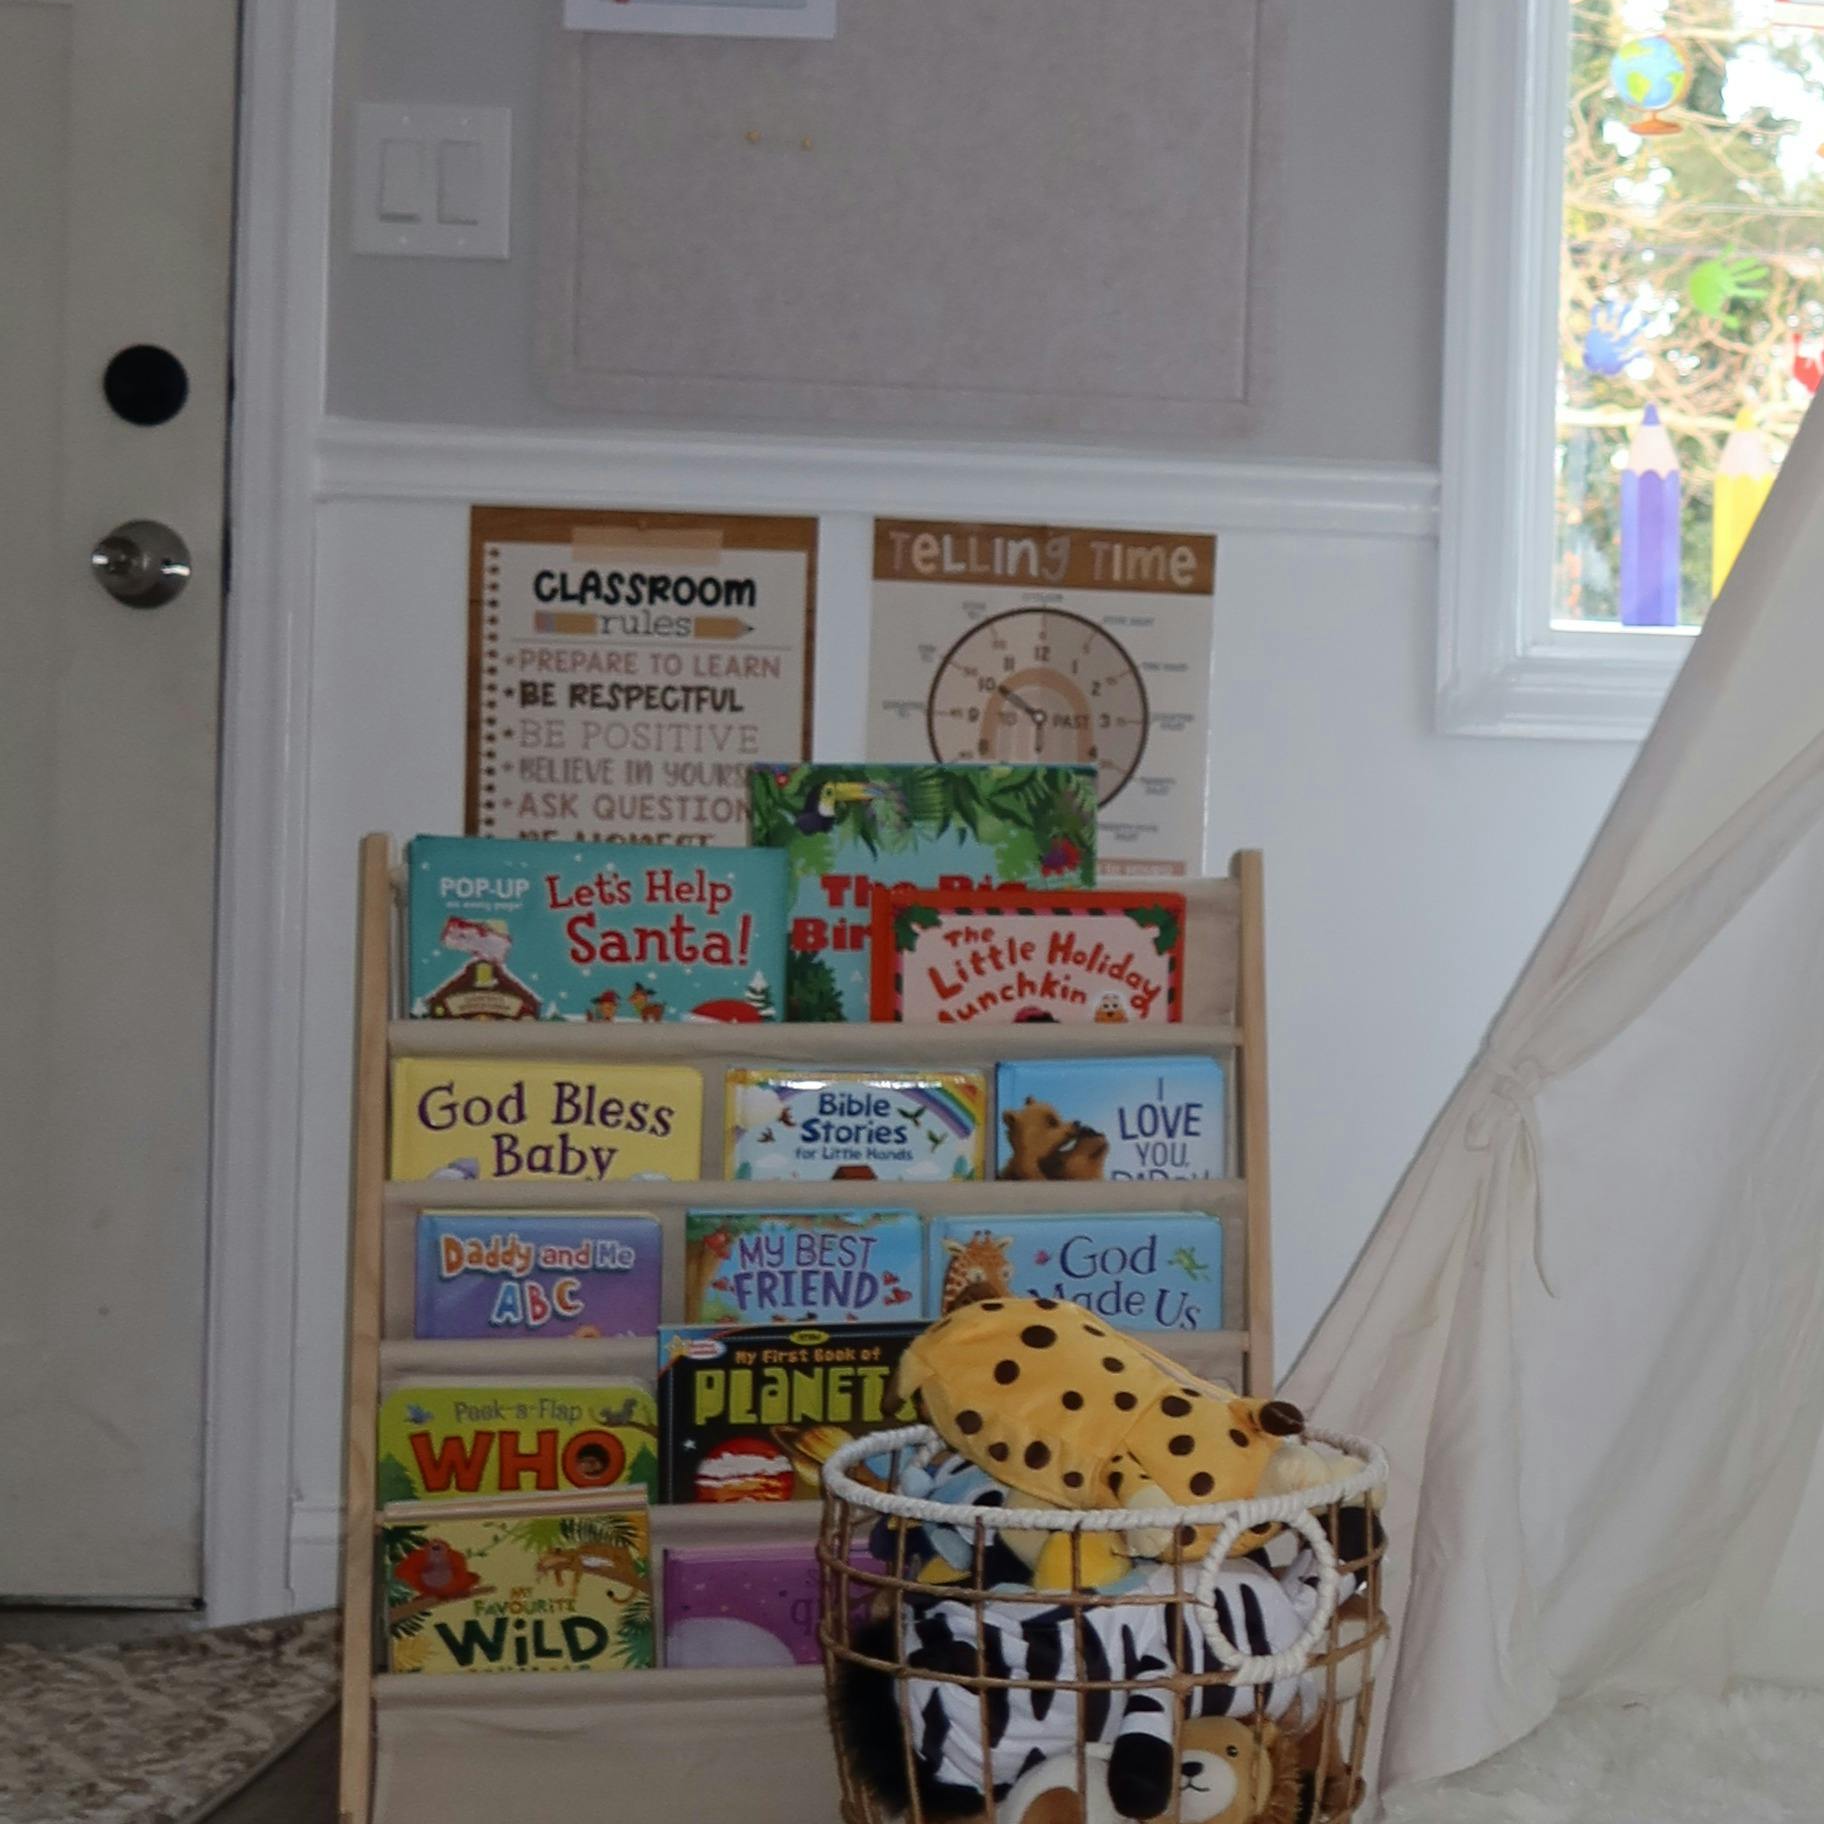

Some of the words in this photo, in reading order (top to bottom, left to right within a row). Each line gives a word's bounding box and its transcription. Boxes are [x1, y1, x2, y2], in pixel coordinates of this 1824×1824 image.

[601, 610, 692, 637] rules
[519, 649, 638, 676] PREPARE
[650, 652, 683, 677] TO
[693, 654, 781, 679] LEARN
[1034, 645, 1050, 662] 12
[519, 681, 555, 707] BE
[569, 682, 744, 713] RESPECTFUL
[978, 677, 996, 693] 10
[1091, 680, 1101, 696] 2
[519, 719, 565, 749] BE
[581, 721, 760, 754] POSITIVE
[1100, 712, 1111, 728] 3
[519, 757, 613, 785] BELIEVE
[517, 793, 579, 820] ASK
[593, 794, 750, 823] QUESTION
[440, 876, 530, 899] POP-UP
[545, 873, 632, 910] Let's
[644, 869, 732, 914] Help
[566, 912, 752, 967] Santa!
[943, 926, 994, 947] The
[928, 937, 1036, 1000] Little
[1047, 930, 1162, 1019] Holiday
[937, 971, 1087, 1022] unchkin
[819, 1093, 891, 1117] Bible
[1157, 1077, 1164, 1101] I
[418, 1080, 527, 1131] God
[551, 1081, 675, 1137] Bless
[1118, 1103, 1203, 1140] LOVE
[800, 1118, 908, 1144] Stories
[491, 1132, 618, 1180] Baby
[440, 1233, 534, 1277] Daddy
[540, 1240, 592, 1269] and
[595, 1240, 635, 1269] Me
[738, 1235, 785, 1270] MY
[795, 1233, 878, 1269] BEST
[1060, 1234, 1157, 1279] God
[491, 1277, 585, 1325] ABC
[733, 1270, 879, 1310] FRIEND
[1155, 1287, 1201, 1330] Us
[735, 1350, 757, 1365] My
[762, 1348, 809, 1363] First
[814, 1347, 857, 1363] Book
[860, 1346, 882, 1361] of
[409, 1429, 627, 1493] WHO
